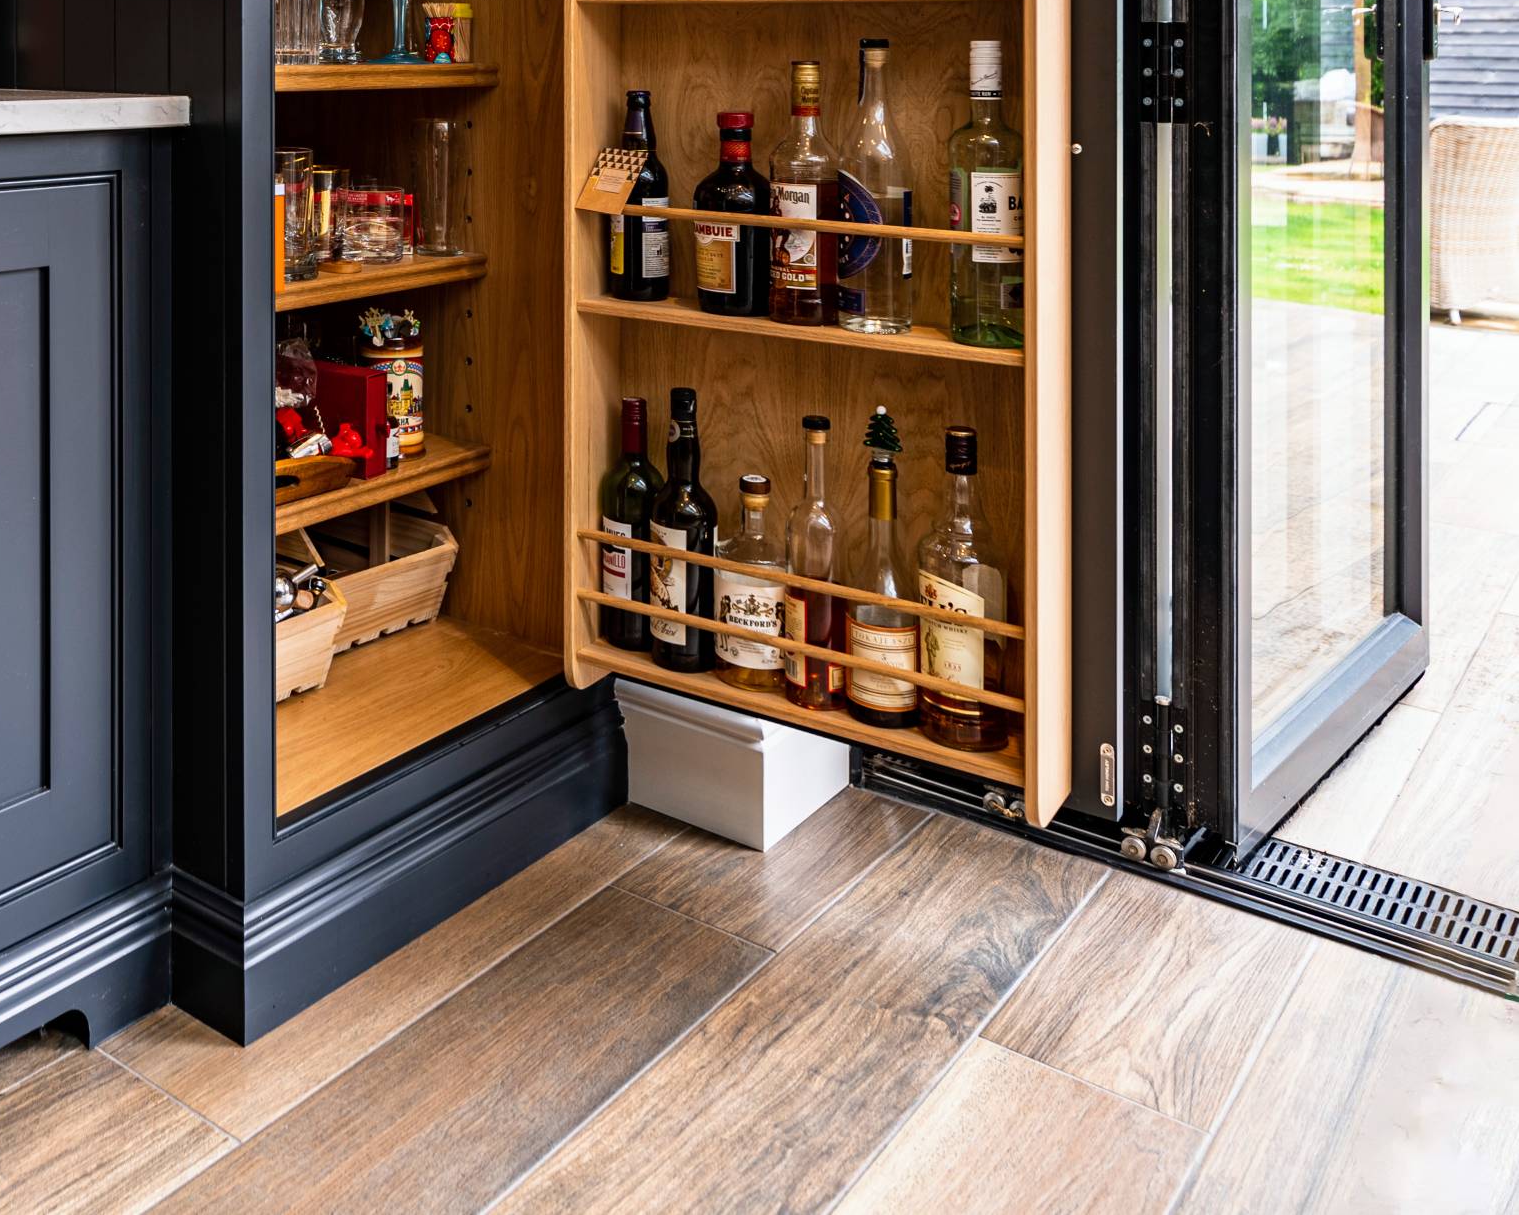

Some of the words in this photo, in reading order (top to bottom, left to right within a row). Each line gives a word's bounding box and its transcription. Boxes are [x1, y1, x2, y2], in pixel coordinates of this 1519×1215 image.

[778, 185, 811, 204] Morgan
[694, 223, 733, 238] AMBUIE
[781, 272, 806, 282] GOLD
[728, 615, 778, 628] BECKFORD'S
